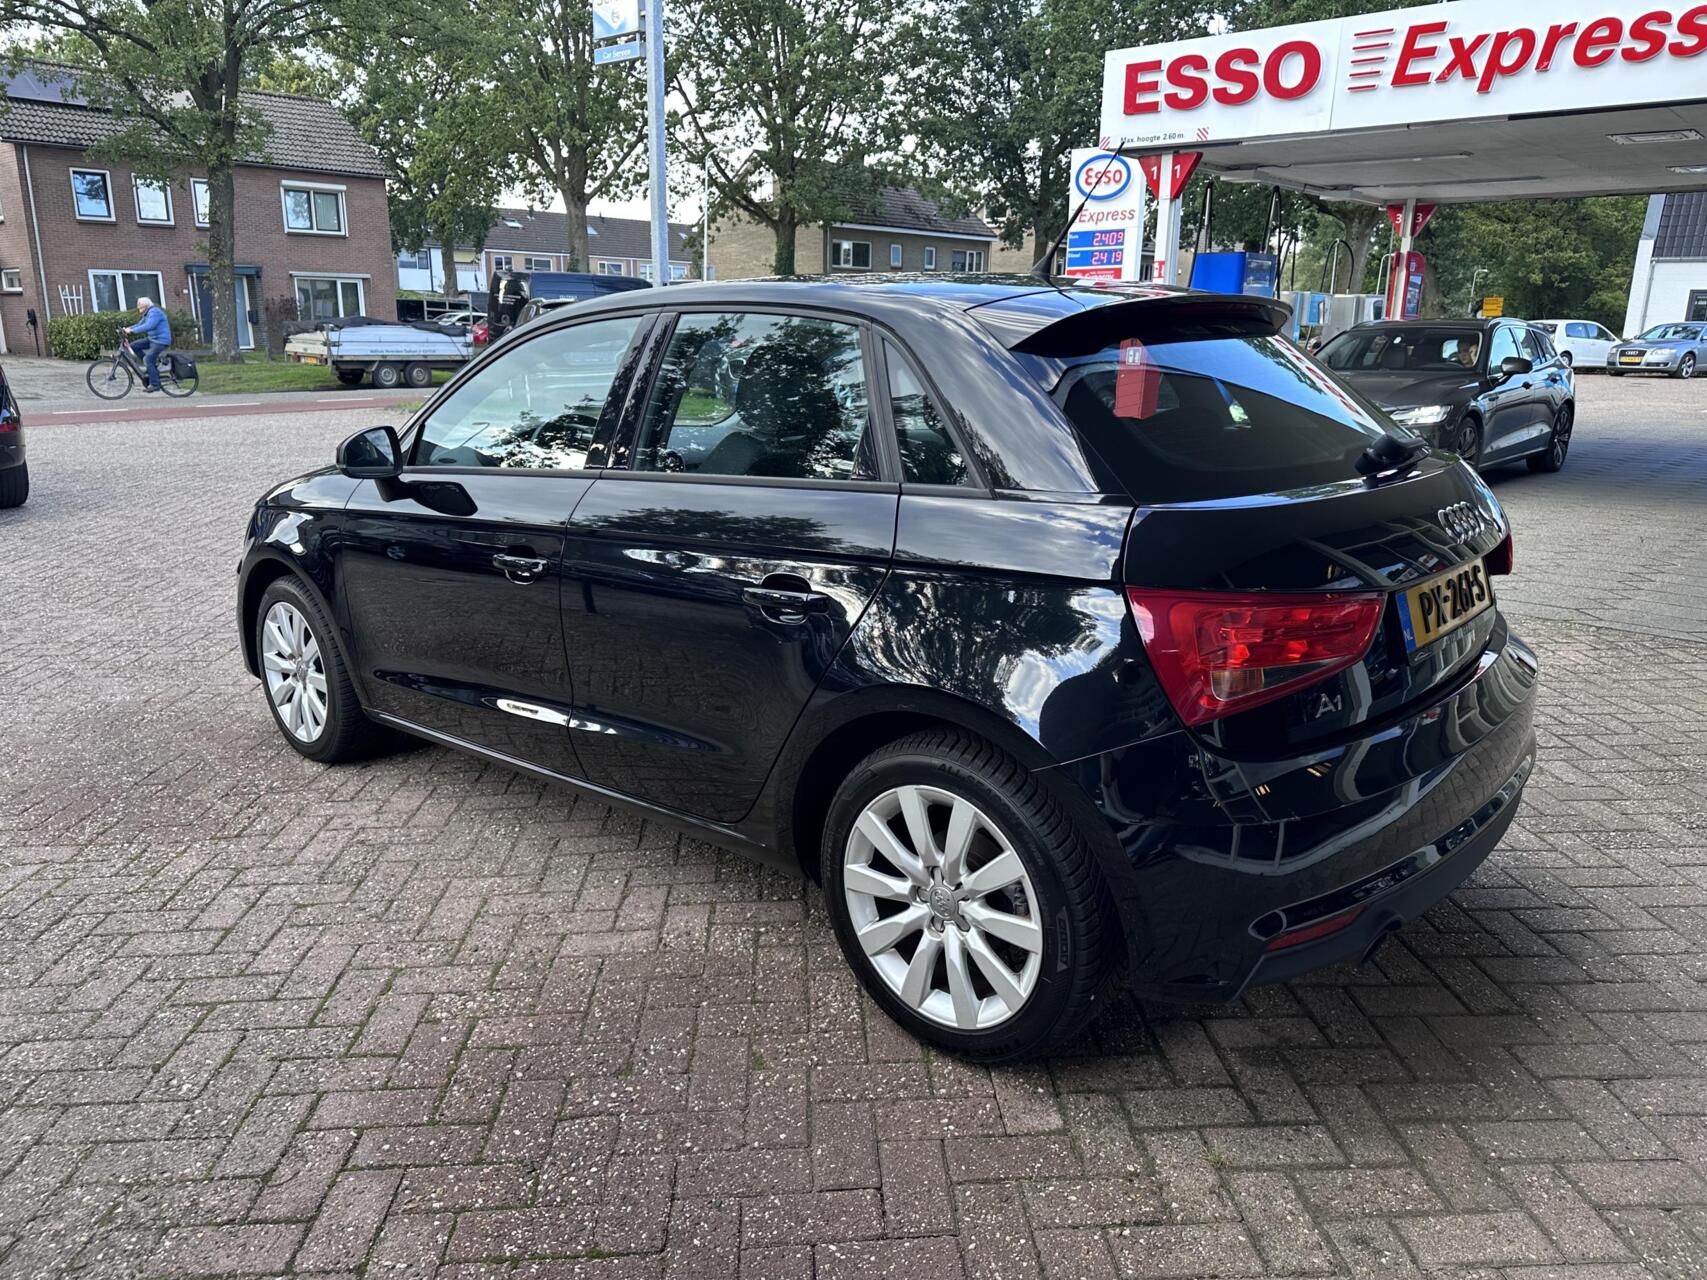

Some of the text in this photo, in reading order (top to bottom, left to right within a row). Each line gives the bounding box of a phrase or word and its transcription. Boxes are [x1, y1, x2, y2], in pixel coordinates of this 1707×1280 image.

[1123, 4, 1707, 116] ESSO Express
[1136, 134, 1160, 143] hoogte
[1151, 165, 1158, 180] 1
[1174, 164, 1181, 179] 1
[1078, 208, 1136, 224] Express
[1395, 213, 1402, 224] 3
[1416, 213, 1422, 223] 3
[1093, 231, 1124, 246] 2.409
[1092, 251, 1122, 265] 2.419
[1403, 628, 1414, 640] NL
[1315, 692, 1342, 719] A1
